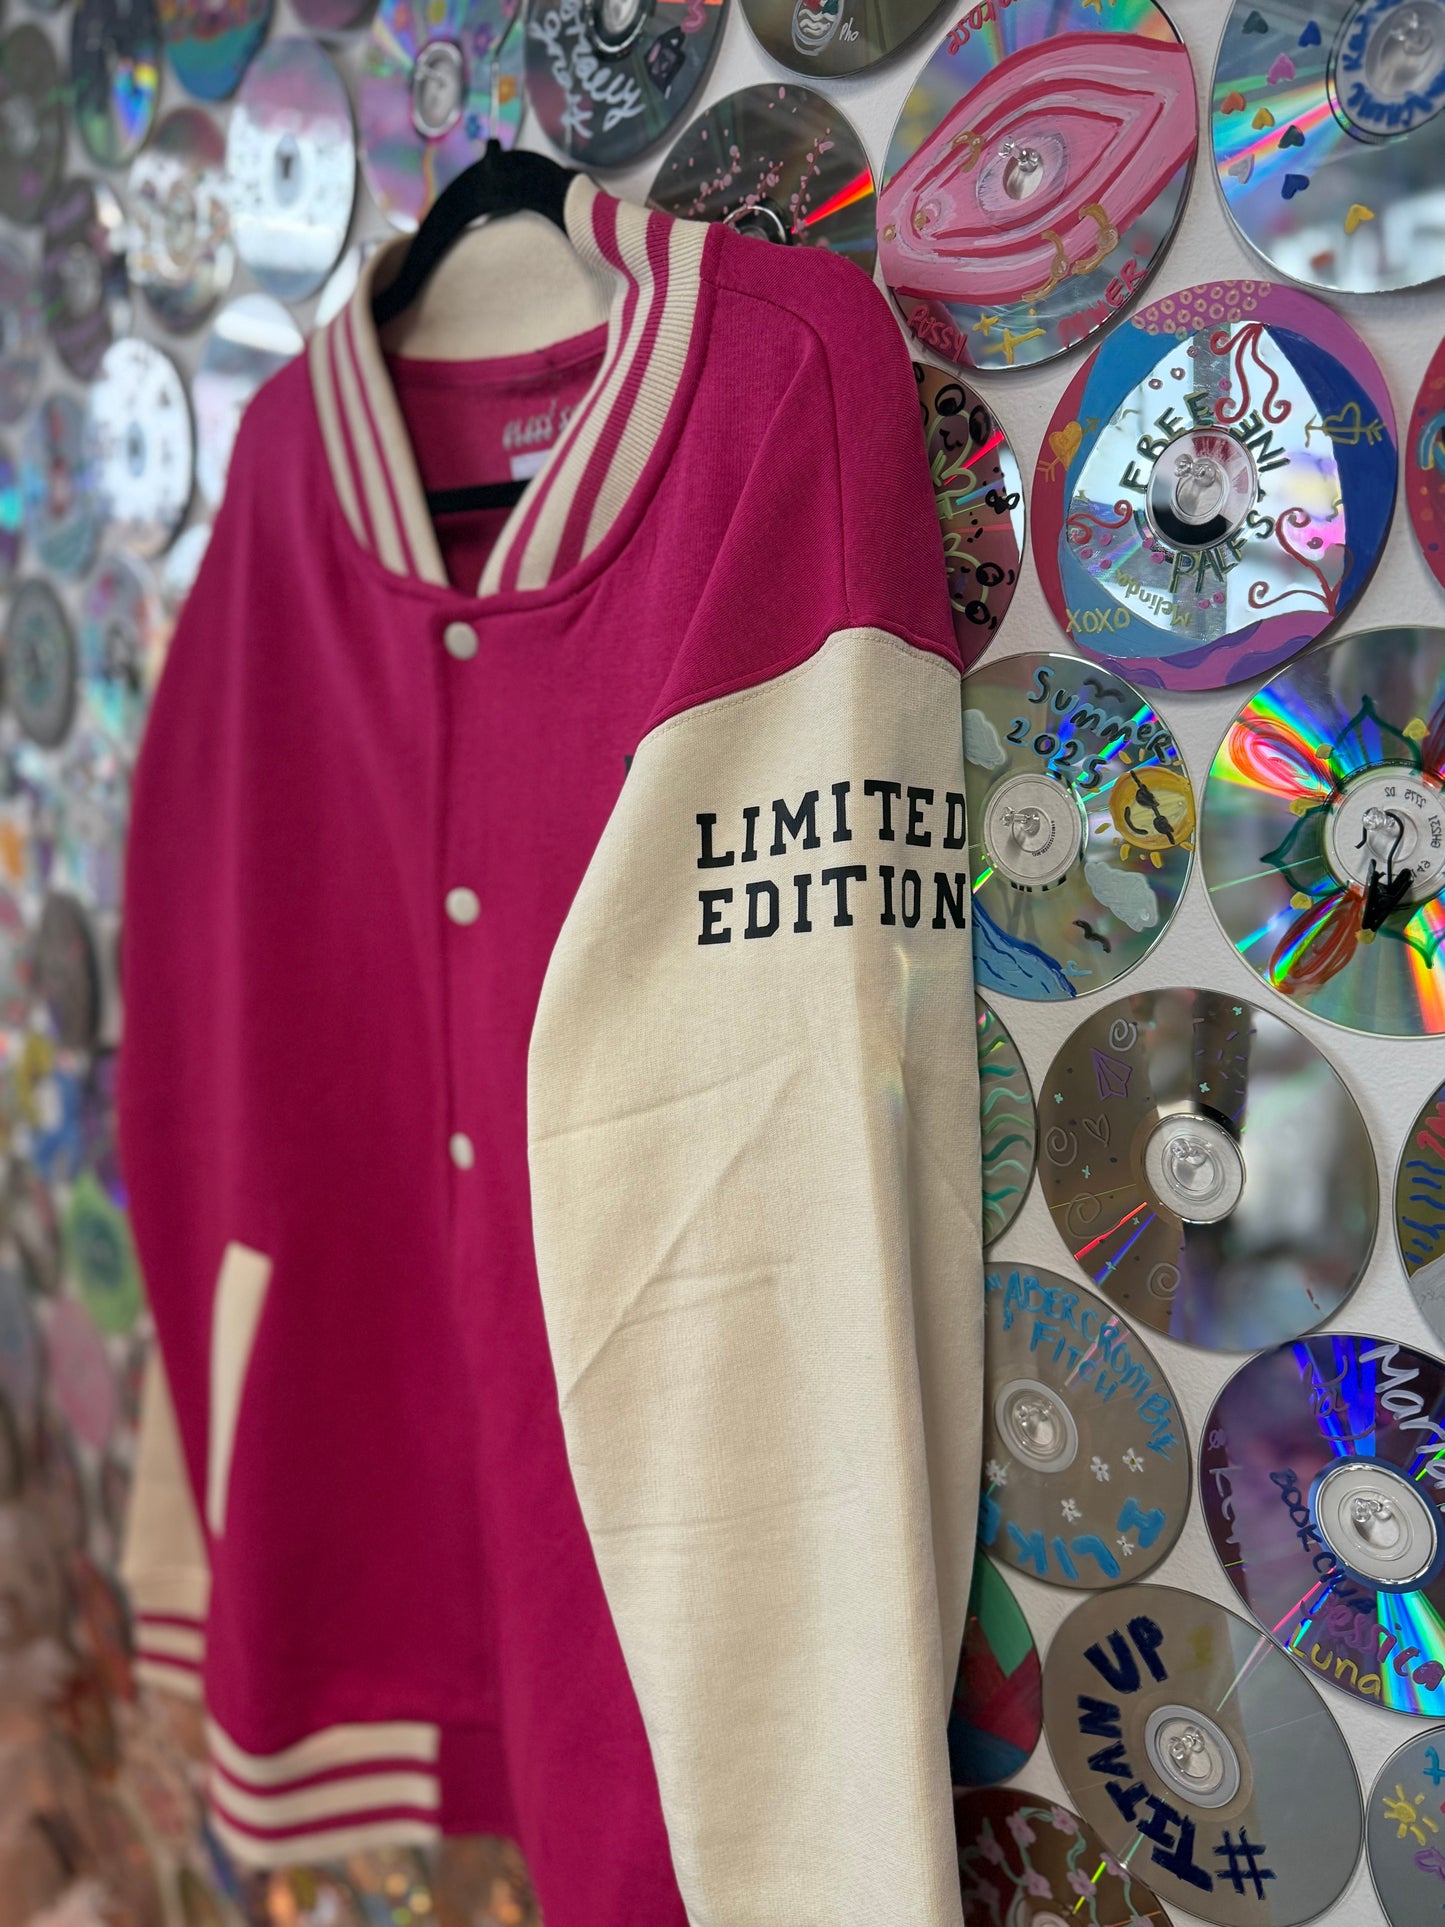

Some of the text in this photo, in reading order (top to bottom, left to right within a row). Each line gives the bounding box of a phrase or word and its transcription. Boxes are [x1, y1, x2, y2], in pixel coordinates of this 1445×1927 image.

[839, 17, 860, 42] Pho
[908, 304, 968, 363] PUSSY
[1065, 607, 1130, 633] XOXO
[1116, 569, 1191, 627] Melinda
[1006, 717, 1108, 789] 2025
[696, 779, 967, 869] LIMITED
[698, 865, 967, 945] EDITION
[1003, 1271, 1181, 1462] ABERCROMBIE
[1030, 1320, 1118, 1403] FITCH
[1083, 1615, 1169, 1695] UP
[1289, 1623, 1382, 1698] Luna
